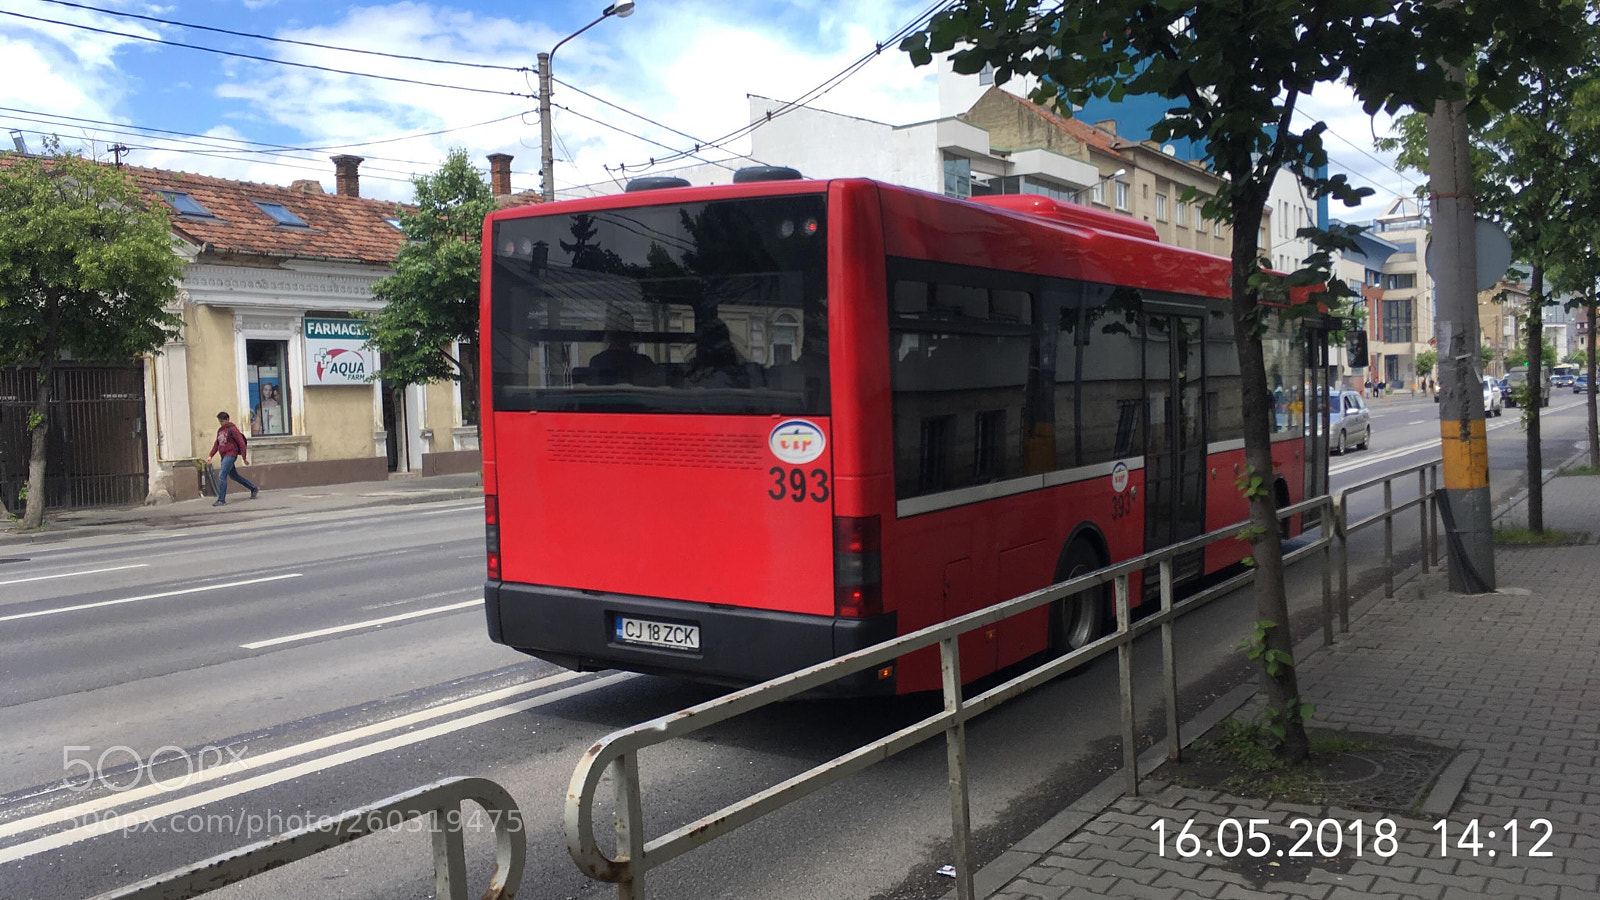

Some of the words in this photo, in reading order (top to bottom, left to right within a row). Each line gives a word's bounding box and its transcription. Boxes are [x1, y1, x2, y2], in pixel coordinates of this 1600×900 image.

[330, 362, 365, 377] AQUA
[768, 466, 829, 503] 393
[625, 621, 643, 639] CJ
[647, 623, 660, 641] 18
[663, 625, 694, 646] ZCK
